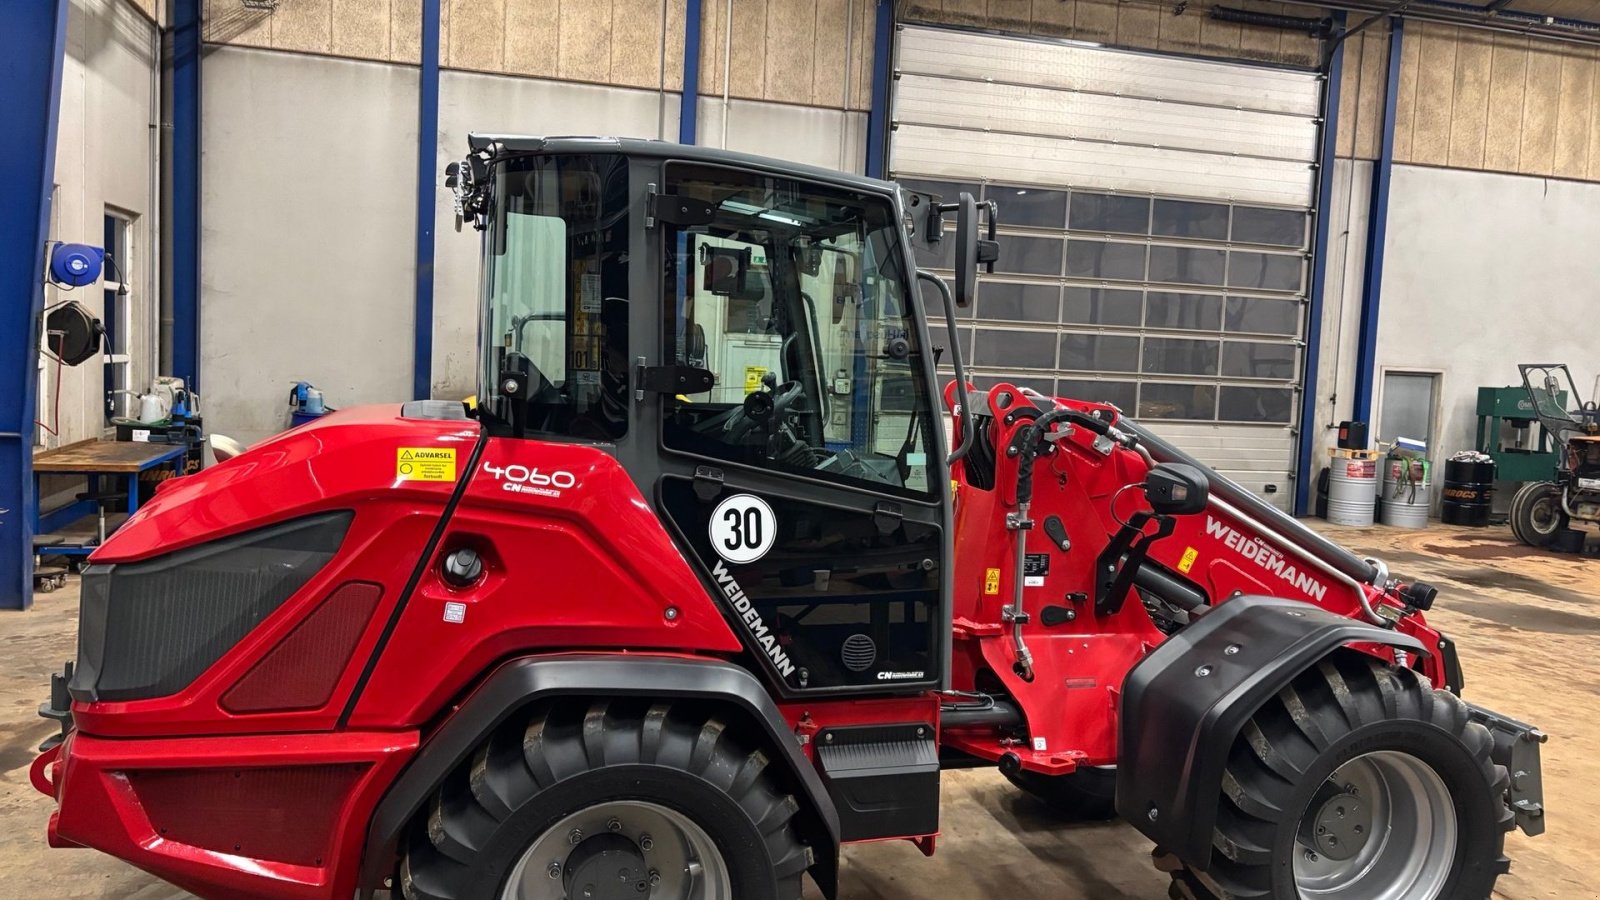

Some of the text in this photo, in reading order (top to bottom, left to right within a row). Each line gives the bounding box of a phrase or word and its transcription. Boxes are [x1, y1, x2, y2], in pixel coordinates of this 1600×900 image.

[415, 451, 452, 459] ADVARSEL
[483, 461, 575, 489] 4060
[502, 482, 522, 492] CN
[723, 506, 763, 551] 30
[1206, 514, 1328, 602] WEIDEMANN
[711, 559, 796, 678] WEIDEMANN
[877, 671, 892, 680] CN
